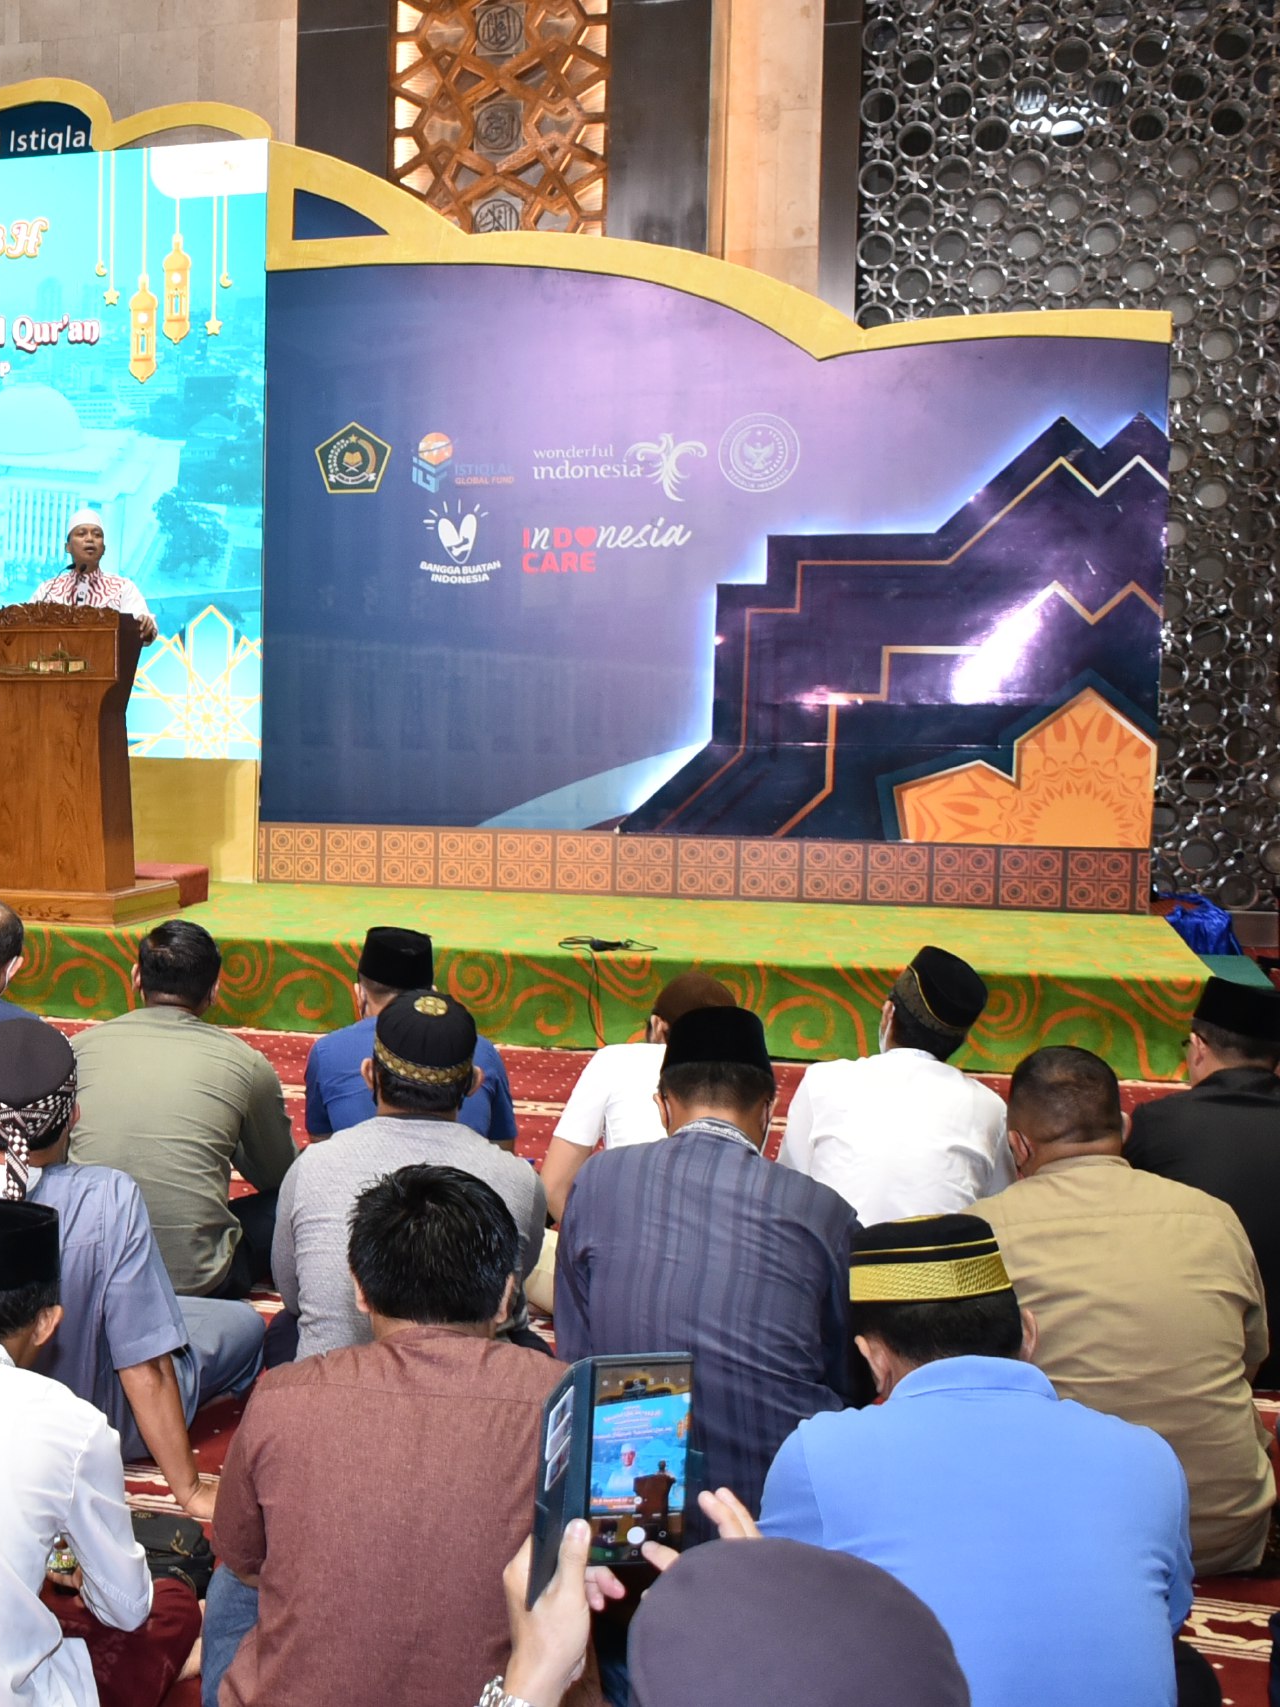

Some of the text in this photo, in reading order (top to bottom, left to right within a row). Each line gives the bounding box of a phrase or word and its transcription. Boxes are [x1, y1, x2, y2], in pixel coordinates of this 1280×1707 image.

[5, 217, 49, 258] H
[12, 313, 100, 354] Qur'an
[533, 444, 614, 460] wonderful
[532, 460, 643, 480] indonesia
[455, 475, 515, 486] GLOBAL FUND
[420, 560, 501, 575] BANGGA BUATAN
[522, 551, 597, 573] CARE
[431, 573, 490, 584] INDONESIA
